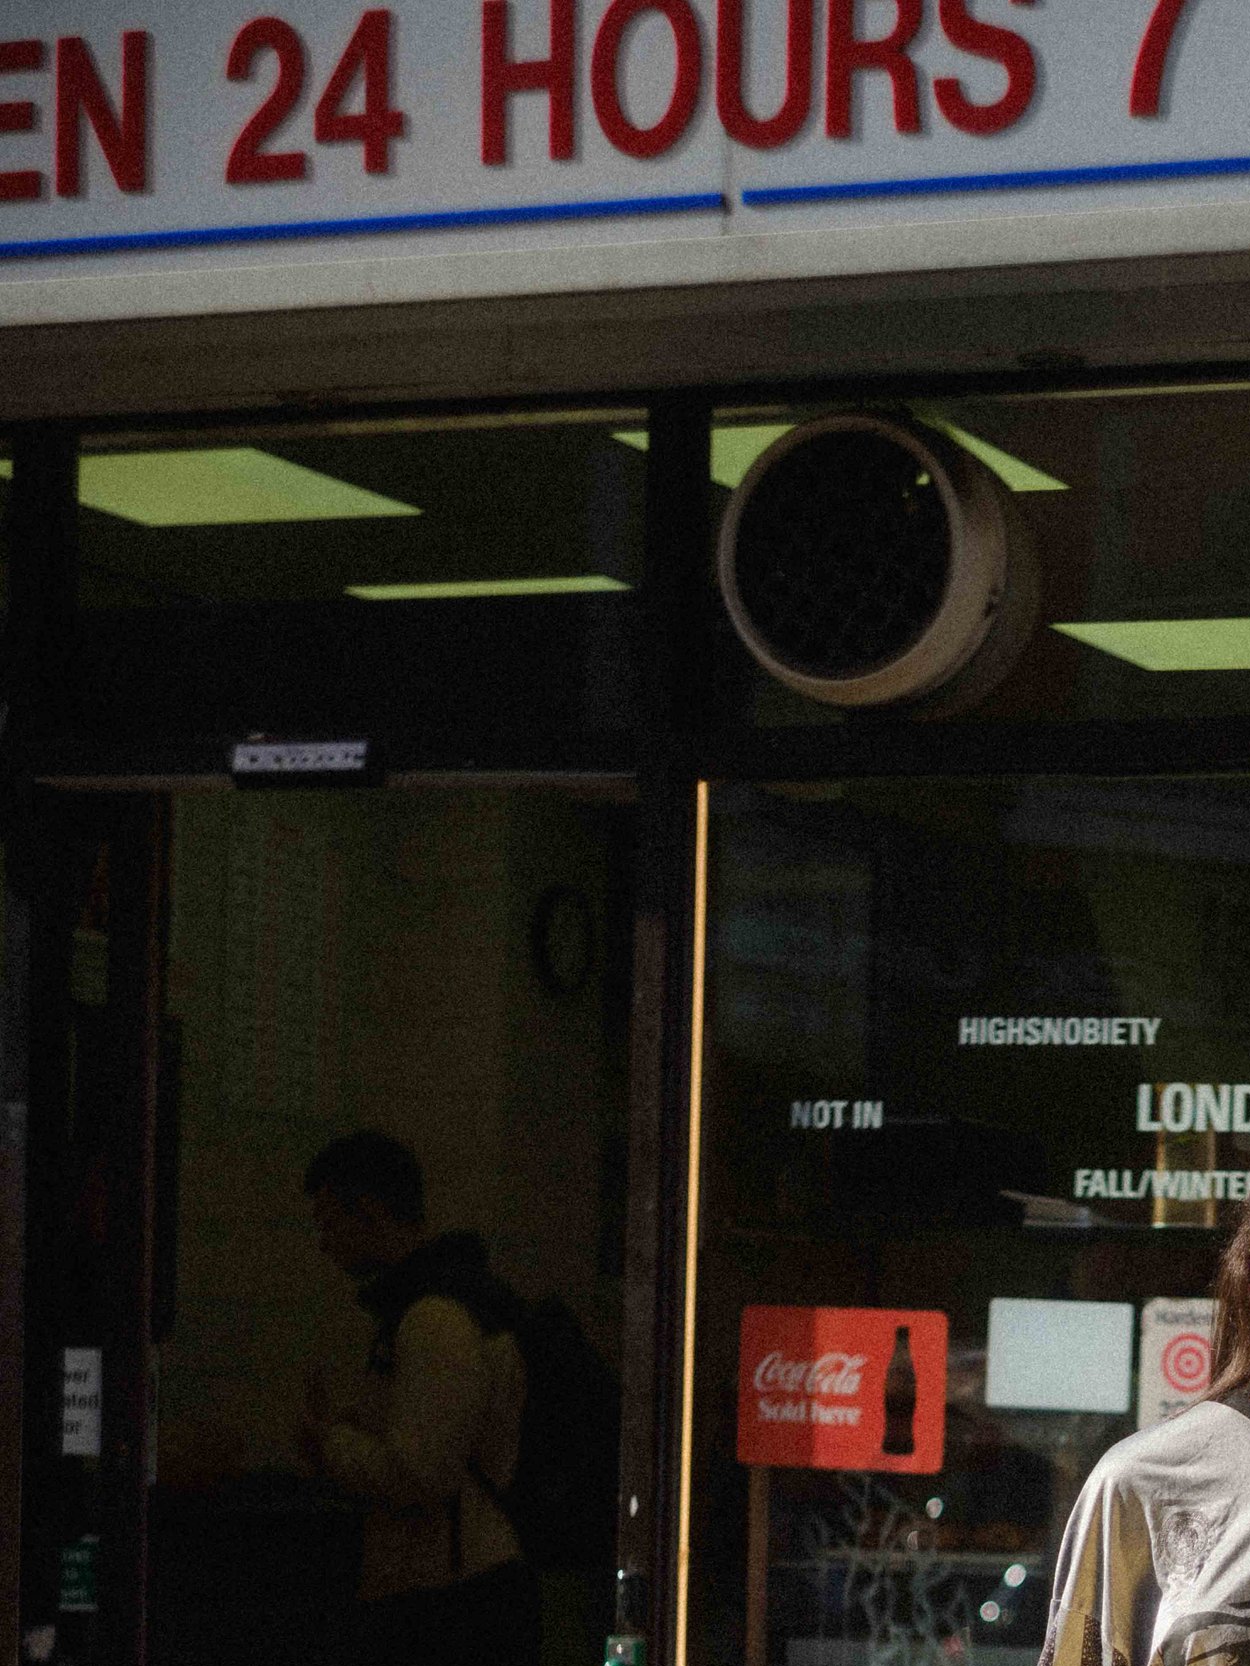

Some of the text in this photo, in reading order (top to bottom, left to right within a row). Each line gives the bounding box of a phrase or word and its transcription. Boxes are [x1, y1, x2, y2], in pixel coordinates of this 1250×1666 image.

[225, 9, 404, 184] 24
[481, 0, 1036, 166] HOURS
[1129, 0, 1187, 118] 7
[959, 1017, 1162, 1045] HIGHSNOBIETY
[791, 1100, 883, 1129] NOT IN
